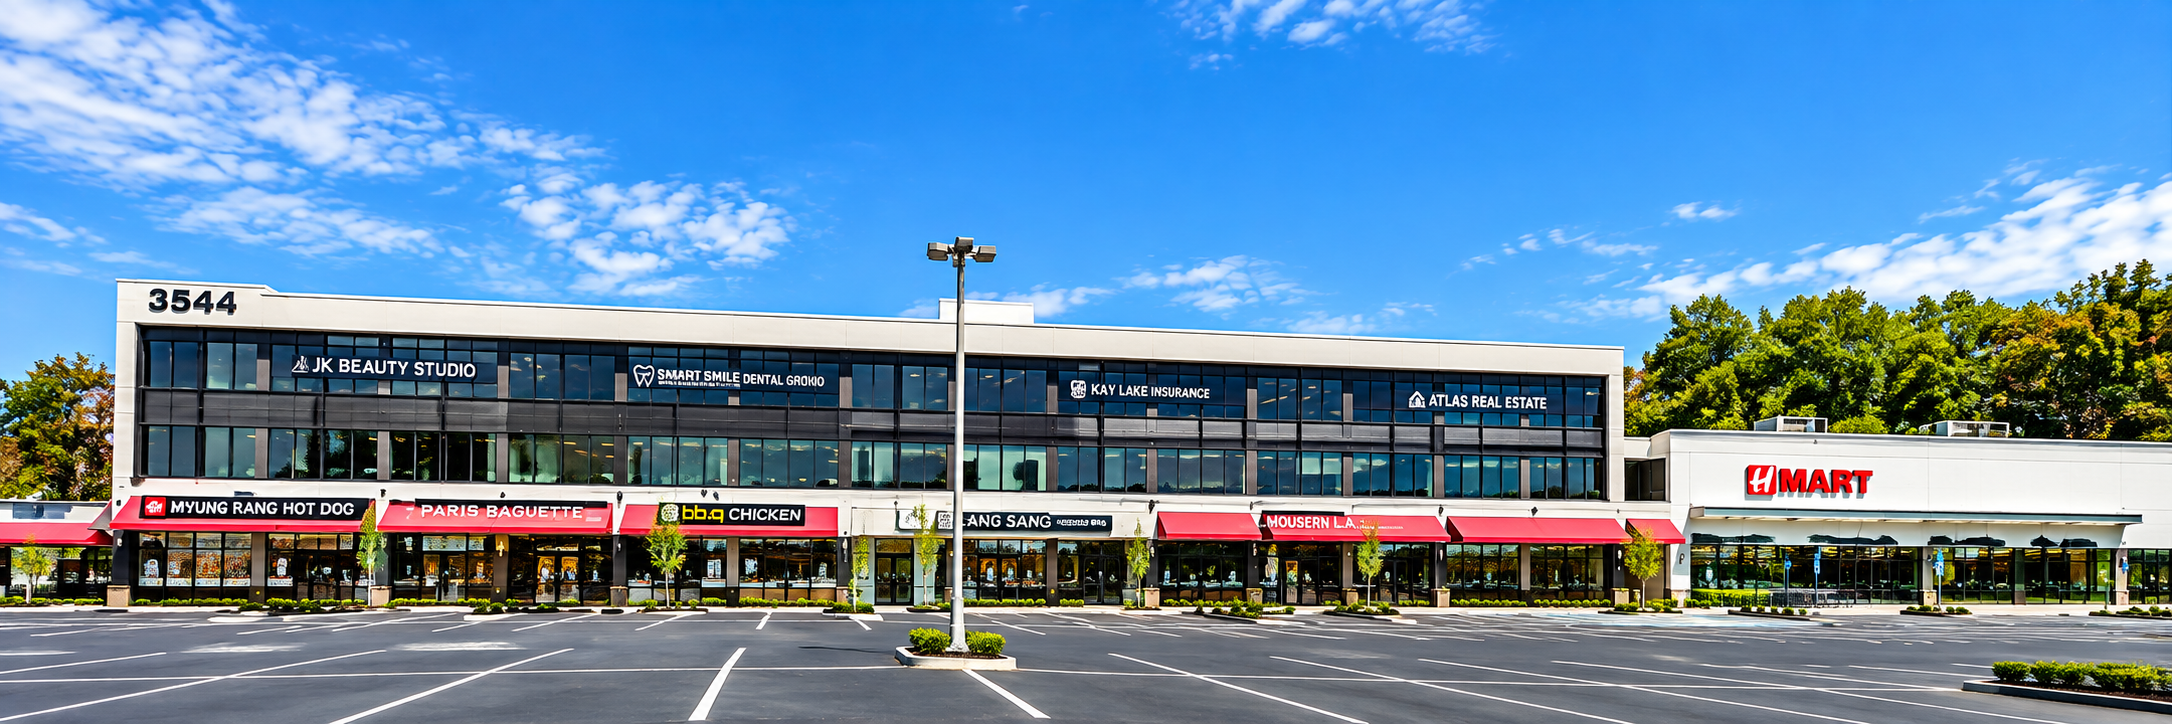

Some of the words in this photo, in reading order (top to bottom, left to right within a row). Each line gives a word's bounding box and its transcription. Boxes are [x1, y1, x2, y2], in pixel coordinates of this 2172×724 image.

[149, 288, 237, 316] 3544
[312, 357, 334, 373] JK
[339, 358, 409, 376] BEAUTY
[414, 361, 477, 378] STUDIO
[657, 368, 701, 382] SMART
[704, 370, 740, 383] SMILE
[743, 373, 784, 386] DENTAL
[1091, 383, 1116, 396] KAY
[1119, 384, 1149, 397] LAKE
[1151, 386, 1210, 399] INSURANCE
[1429, 394, 1468, 408] ATLAS
[1471, 395, 1502, 408] REAL
[1505, 396, 1547, 409] ESTATE
[1749, 465, 1775, 494] H
[1779, 468, 1873, 495] MART
[170, 500, 228, 514] MYUNG
[232, 501, 278, 515] RANG
[282, 502, 316, 515] HOT
[320, 502, 355, 516] DOG
[421, 505, 479, 518] PARIS
[486, 505, 584, 519] BAGUETTE
[682, 504, 725, 523] bb.q
[728, 508, 801, 521] CHICKEN
[962, 514, 1002, 528] ANG
[1005, 515, 1052, 528] SANG
